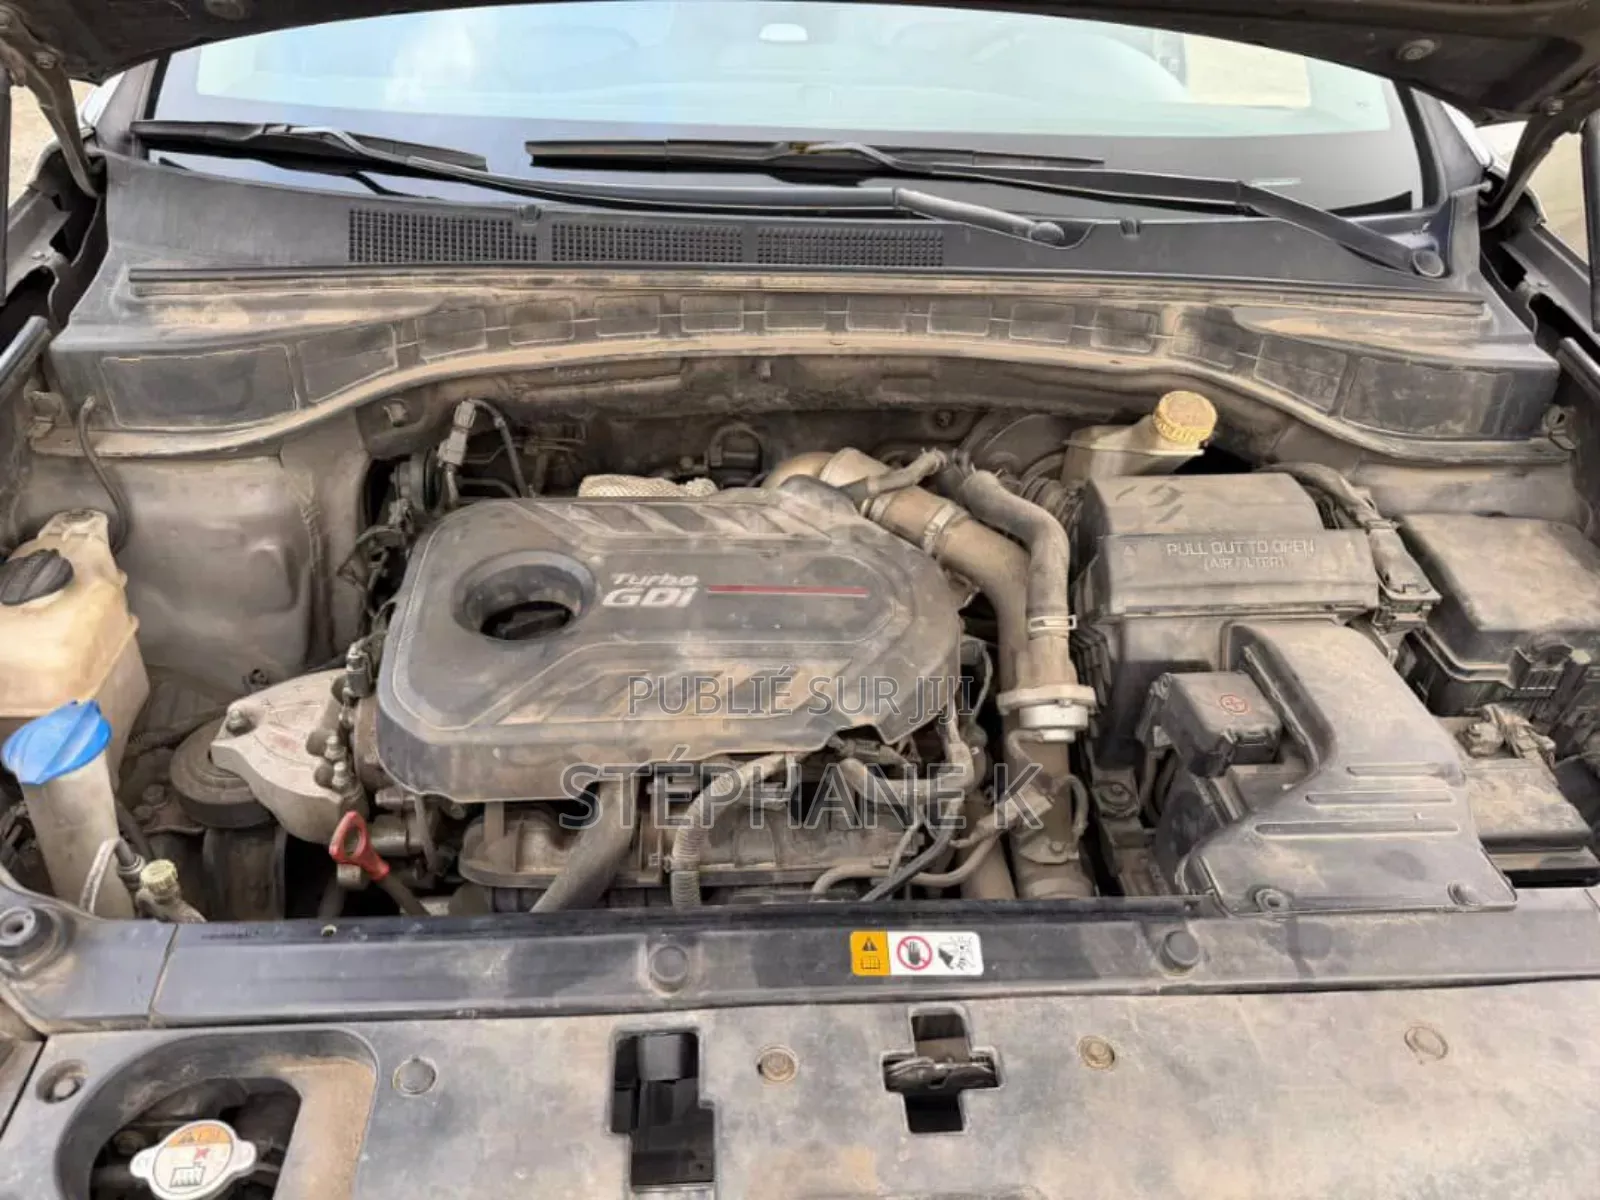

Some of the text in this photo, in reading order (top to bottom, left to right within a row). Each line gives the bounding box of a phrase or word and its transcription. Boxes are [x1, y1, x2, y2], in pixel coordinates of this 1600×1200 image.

[1166, 539, 1315, 557] PULL OUT TO OPEN
[611, 572, 698, 586] Turbo
